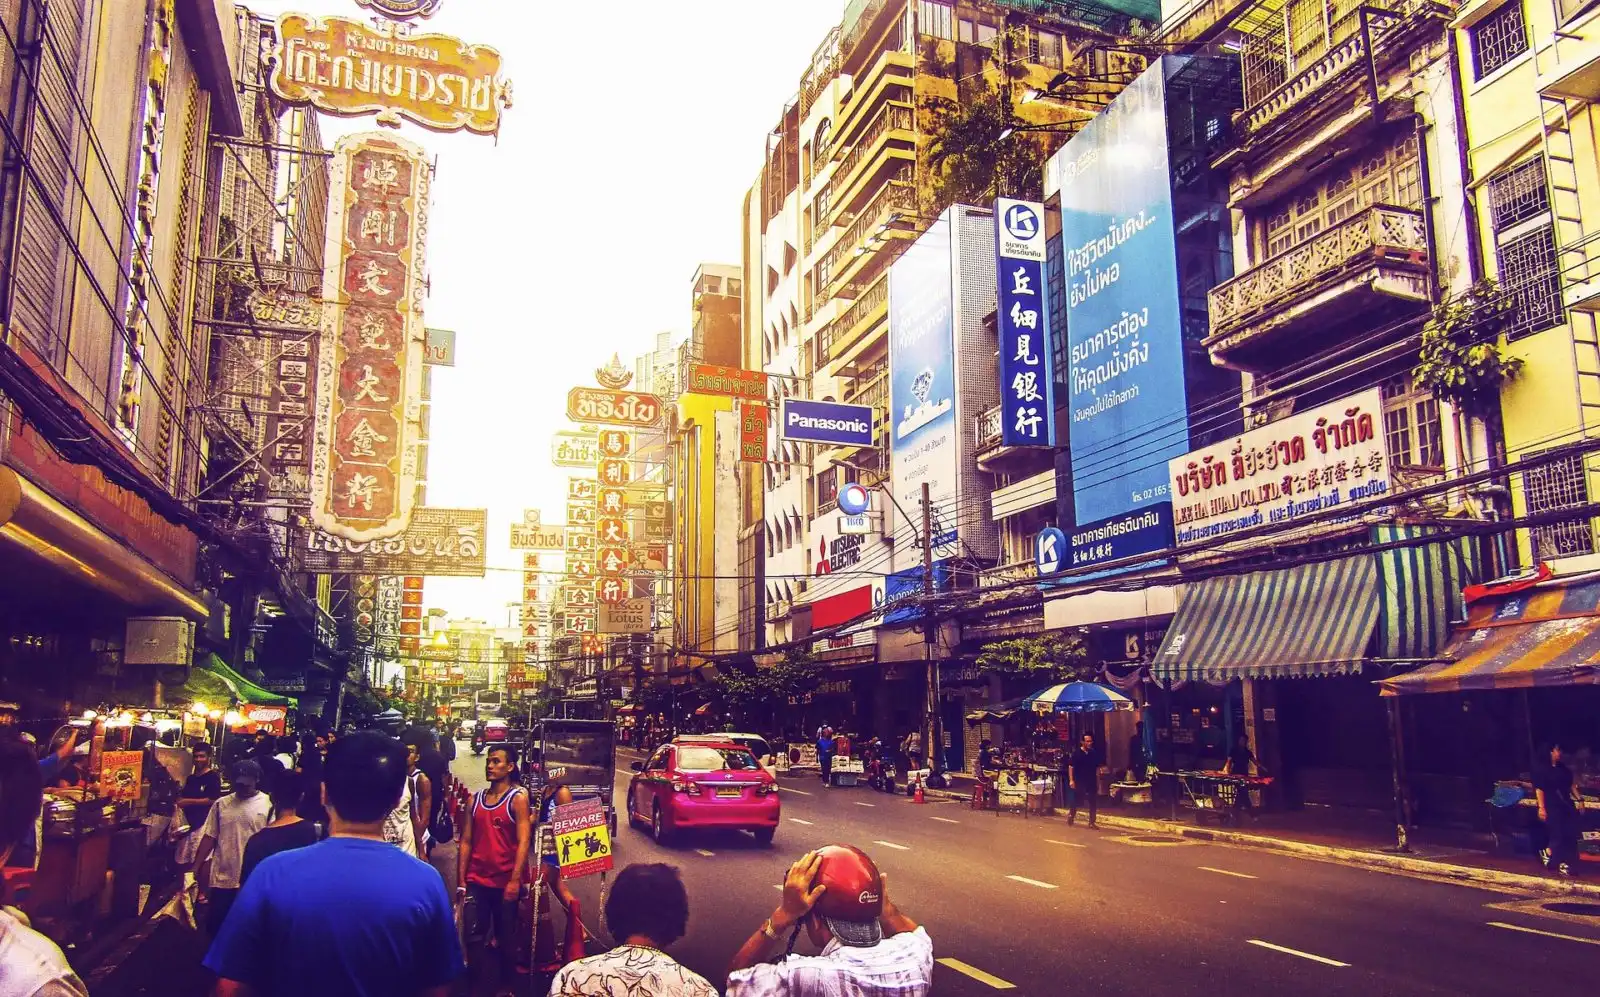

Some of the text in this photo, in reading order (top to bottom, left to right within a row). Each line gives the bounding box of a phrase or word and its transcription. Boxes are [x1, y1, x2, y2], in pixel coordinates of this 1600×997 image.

[1009, 266, 1044, 439] 丘細見銀行
[577, 395, 655, 422] ทองใบ
[788, 411, 868, 434] Panasonic
[1175, 455, 1227, 496] บริษัท
[1312, 406, 1375, 454] จำกัด
[1143, 488, 1152, 500] 02
[847, 517, 864, 526] TISCO
[1072, 511, 1159, 547] ธนาคารเกียรตินาคิน
[608, 613, 644, 623] Lotus
[554, 812, 603, 831] BEWARE
